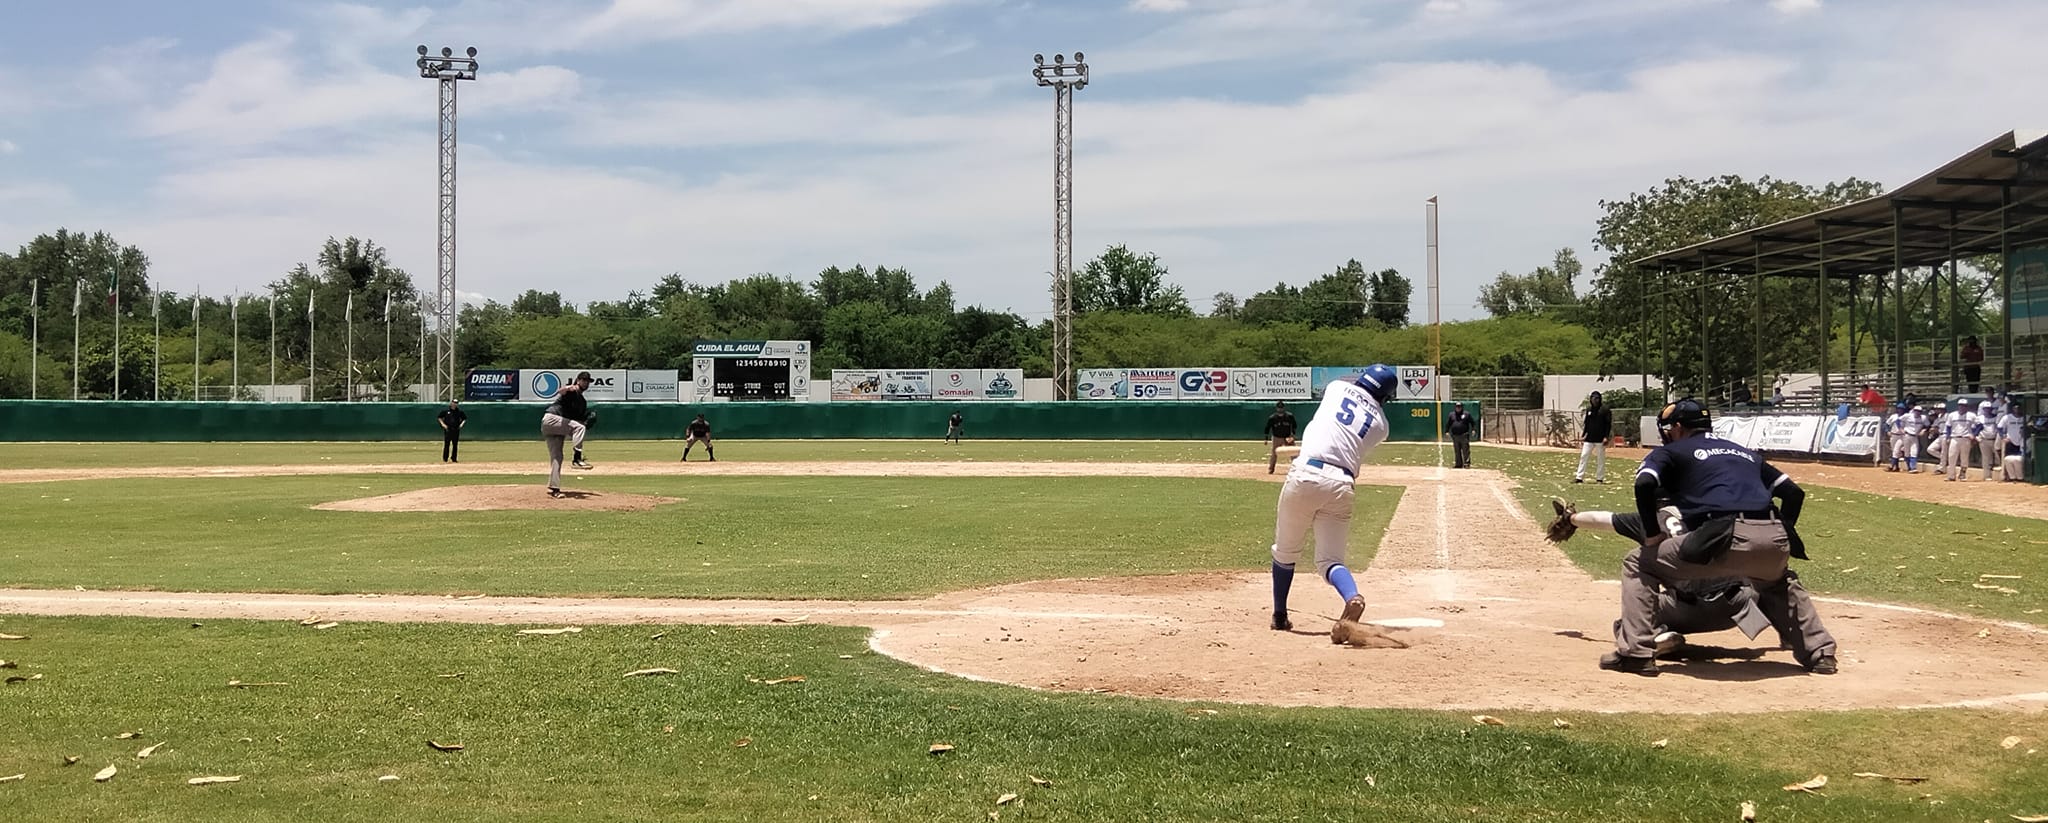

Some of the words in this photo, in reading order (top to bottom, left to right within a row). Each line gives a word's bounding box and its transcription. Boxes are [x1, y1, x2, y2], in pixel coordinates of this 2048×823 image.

[471, 374, 514, 384] DRENAX
[1336, 397, 1376, 439] 51
[1411, 408, 1430, 418] 300
